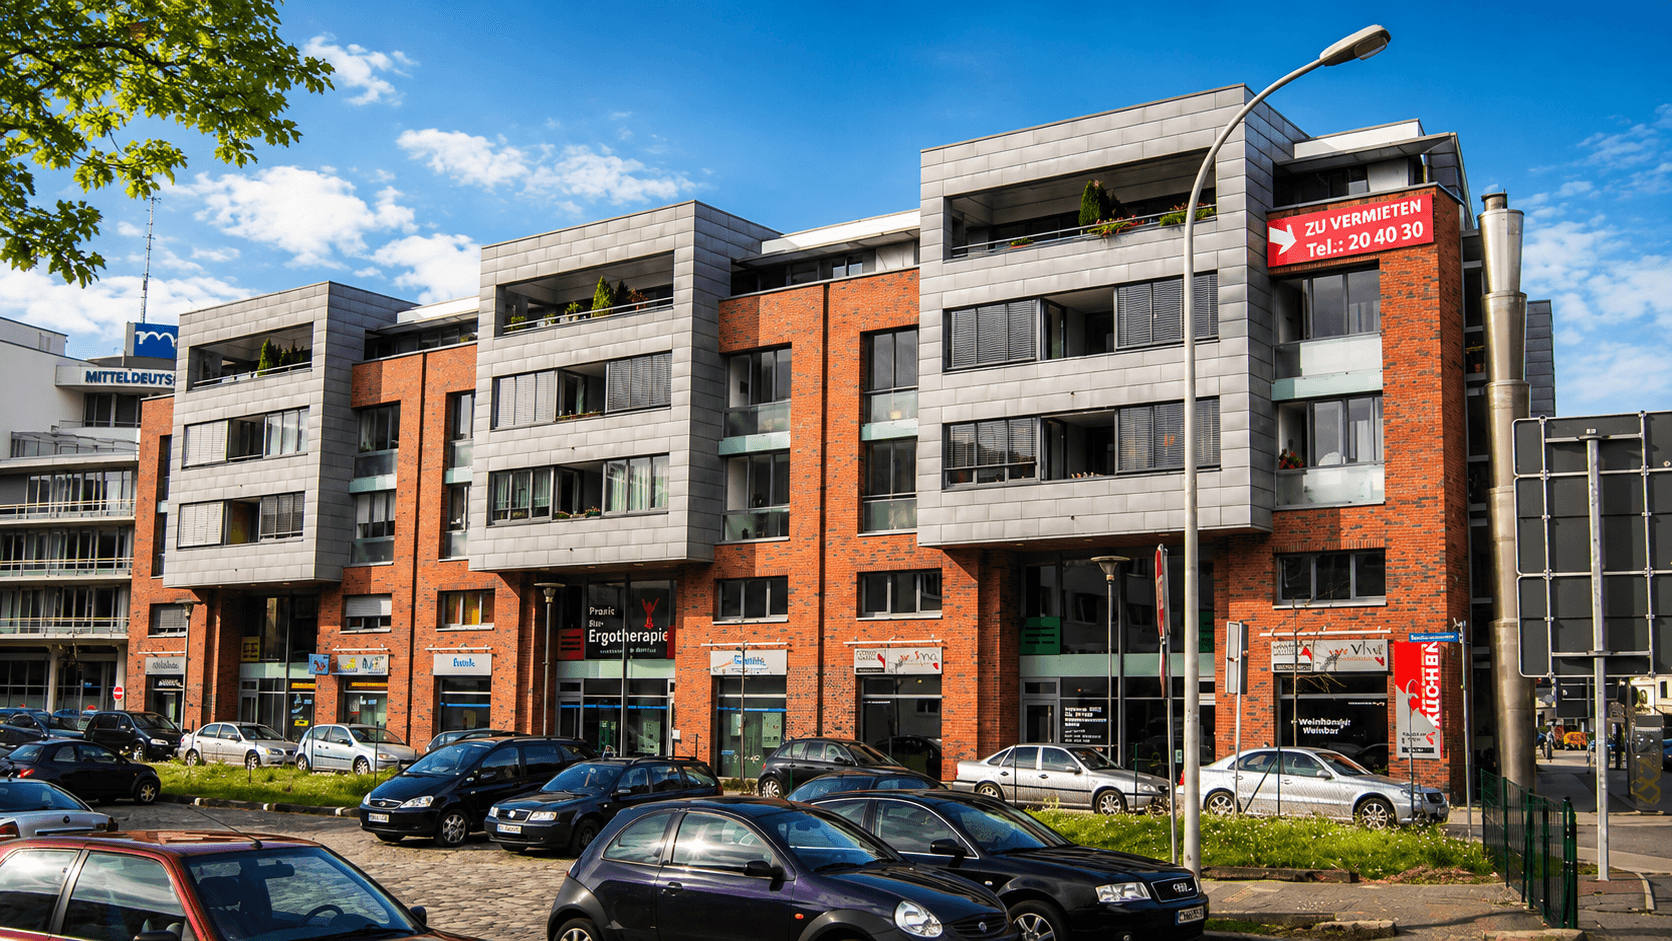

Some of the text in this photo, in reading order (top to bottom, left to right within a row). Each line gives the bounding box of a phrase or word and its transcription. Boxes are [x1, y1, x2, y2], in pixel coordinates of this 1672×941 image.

[1305, 199, 1422, 236] ZU VERMIETEN
[1306, 221, 1424, 258] Tel.: 20 40 30
[85, 370, 175, 386] MITTELDEUTS
[589, 628, 668, 646] Ergotherapie
